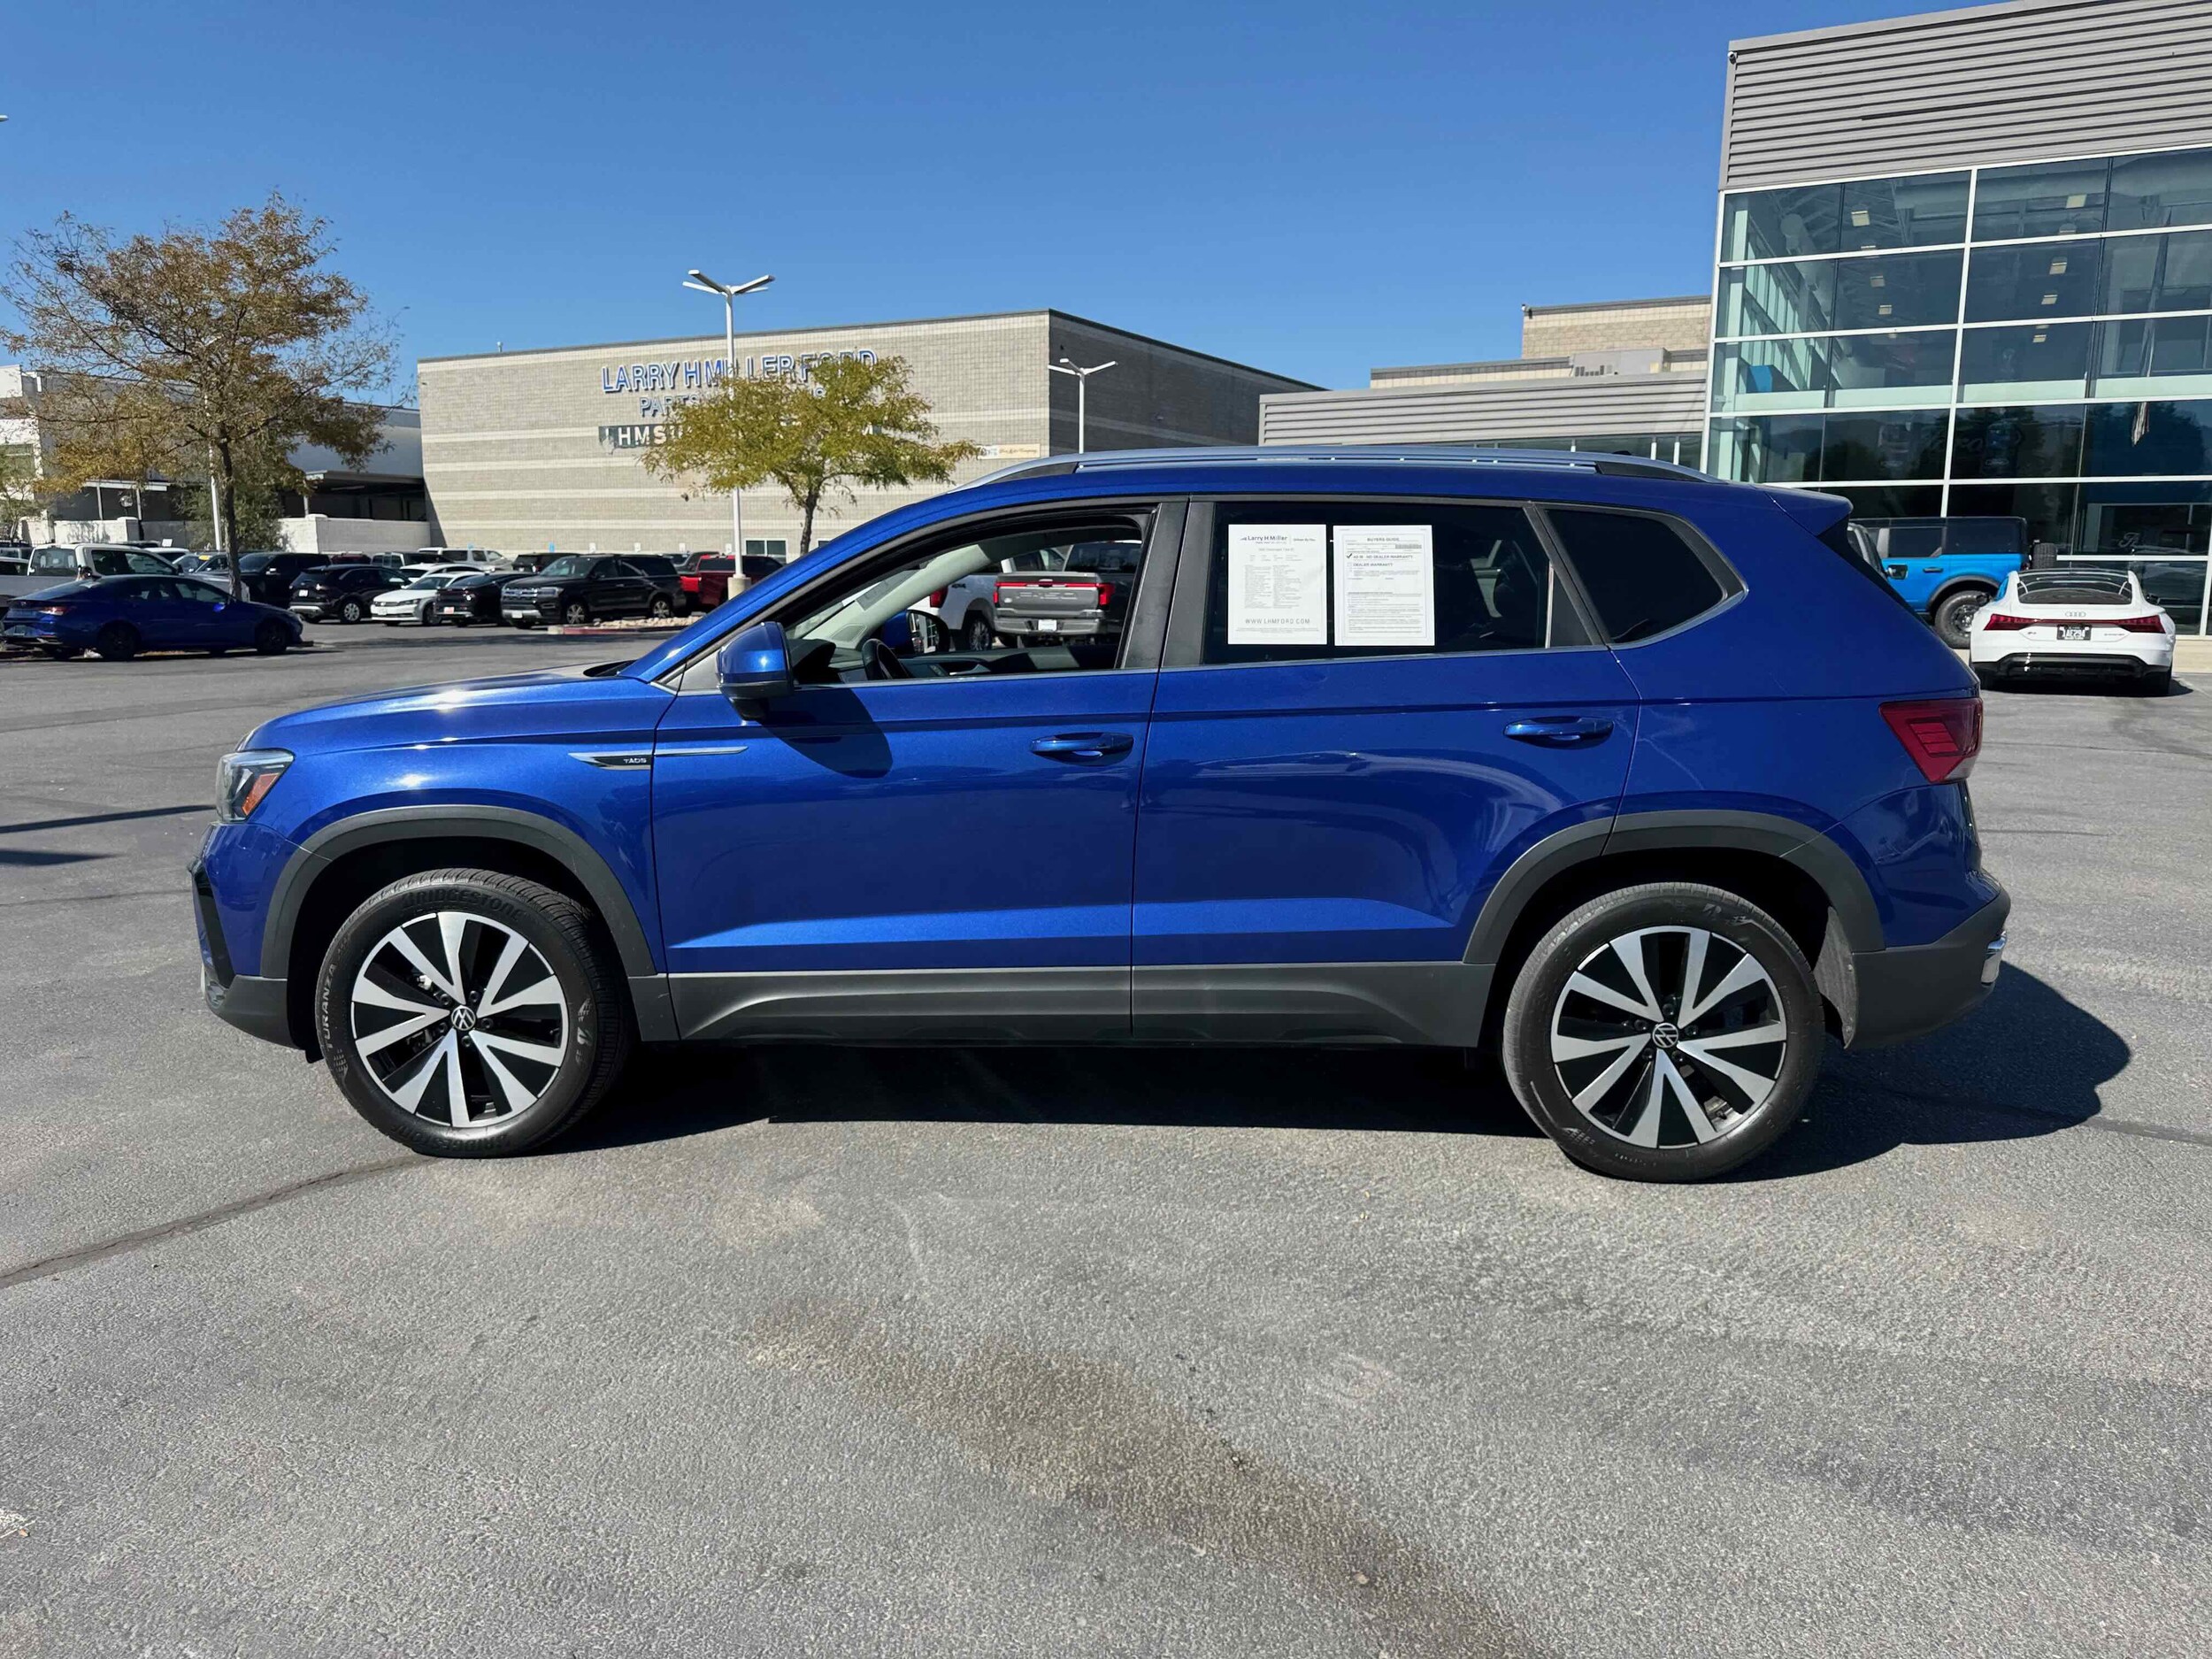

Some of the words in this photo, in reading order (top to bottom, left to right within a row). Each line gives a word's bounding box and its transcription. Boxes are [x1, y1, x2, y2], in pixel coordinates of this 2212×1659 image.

[602, 360, 680, 393] LARRY
[683, 359, 702, 388] H
[704, 355, 796, 388] MILER
[321, 963, 337, 1051] TURANZA
